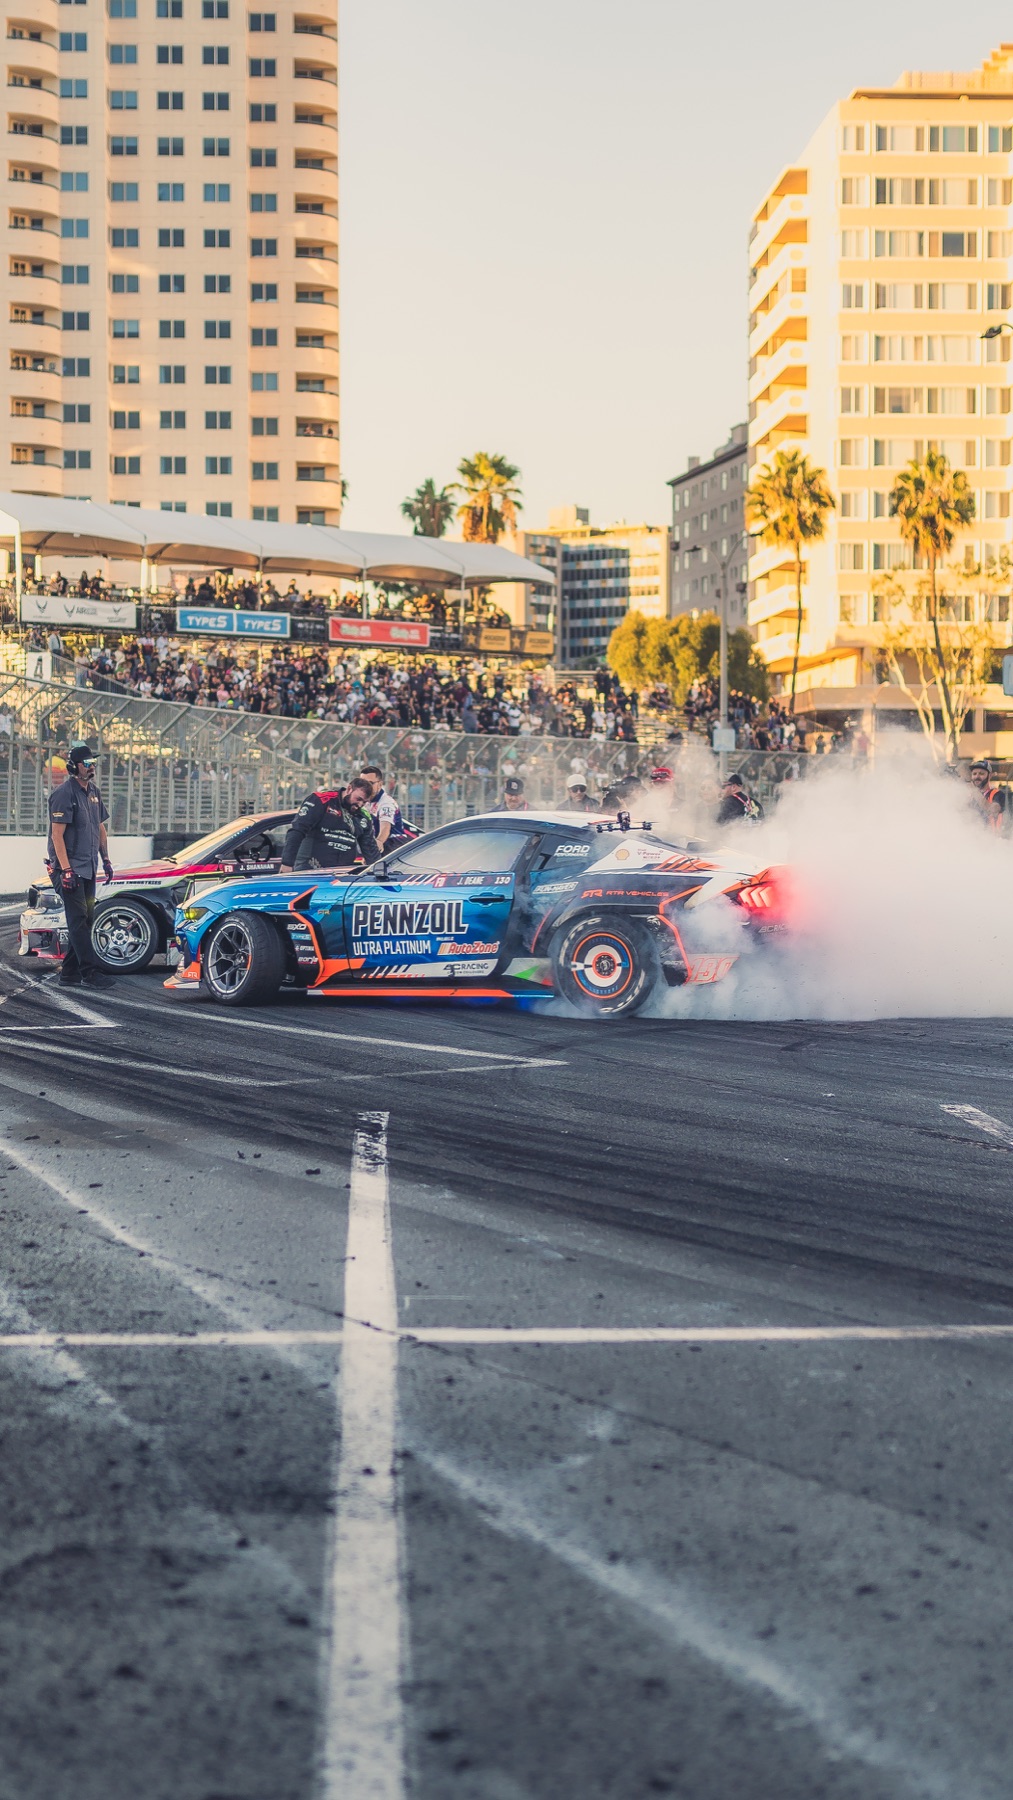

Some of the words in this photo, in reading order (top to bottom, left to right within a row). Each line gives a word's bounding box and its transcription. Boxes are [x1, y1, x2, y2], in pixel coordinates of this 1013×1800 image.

[246, 863, 275, 871] SHANAHAN
[457, 877, 464, 886] J.
[464, 876, 485, 886] DEANE
[494, 876, 511, 885] 130
[352, 900, 469, 937] PENNZOIL
[352, 941, 383, 956] ULTRA
[383, 940, 432, 955] PLATINUM
[448, 941, 499, 955] AutoZone
